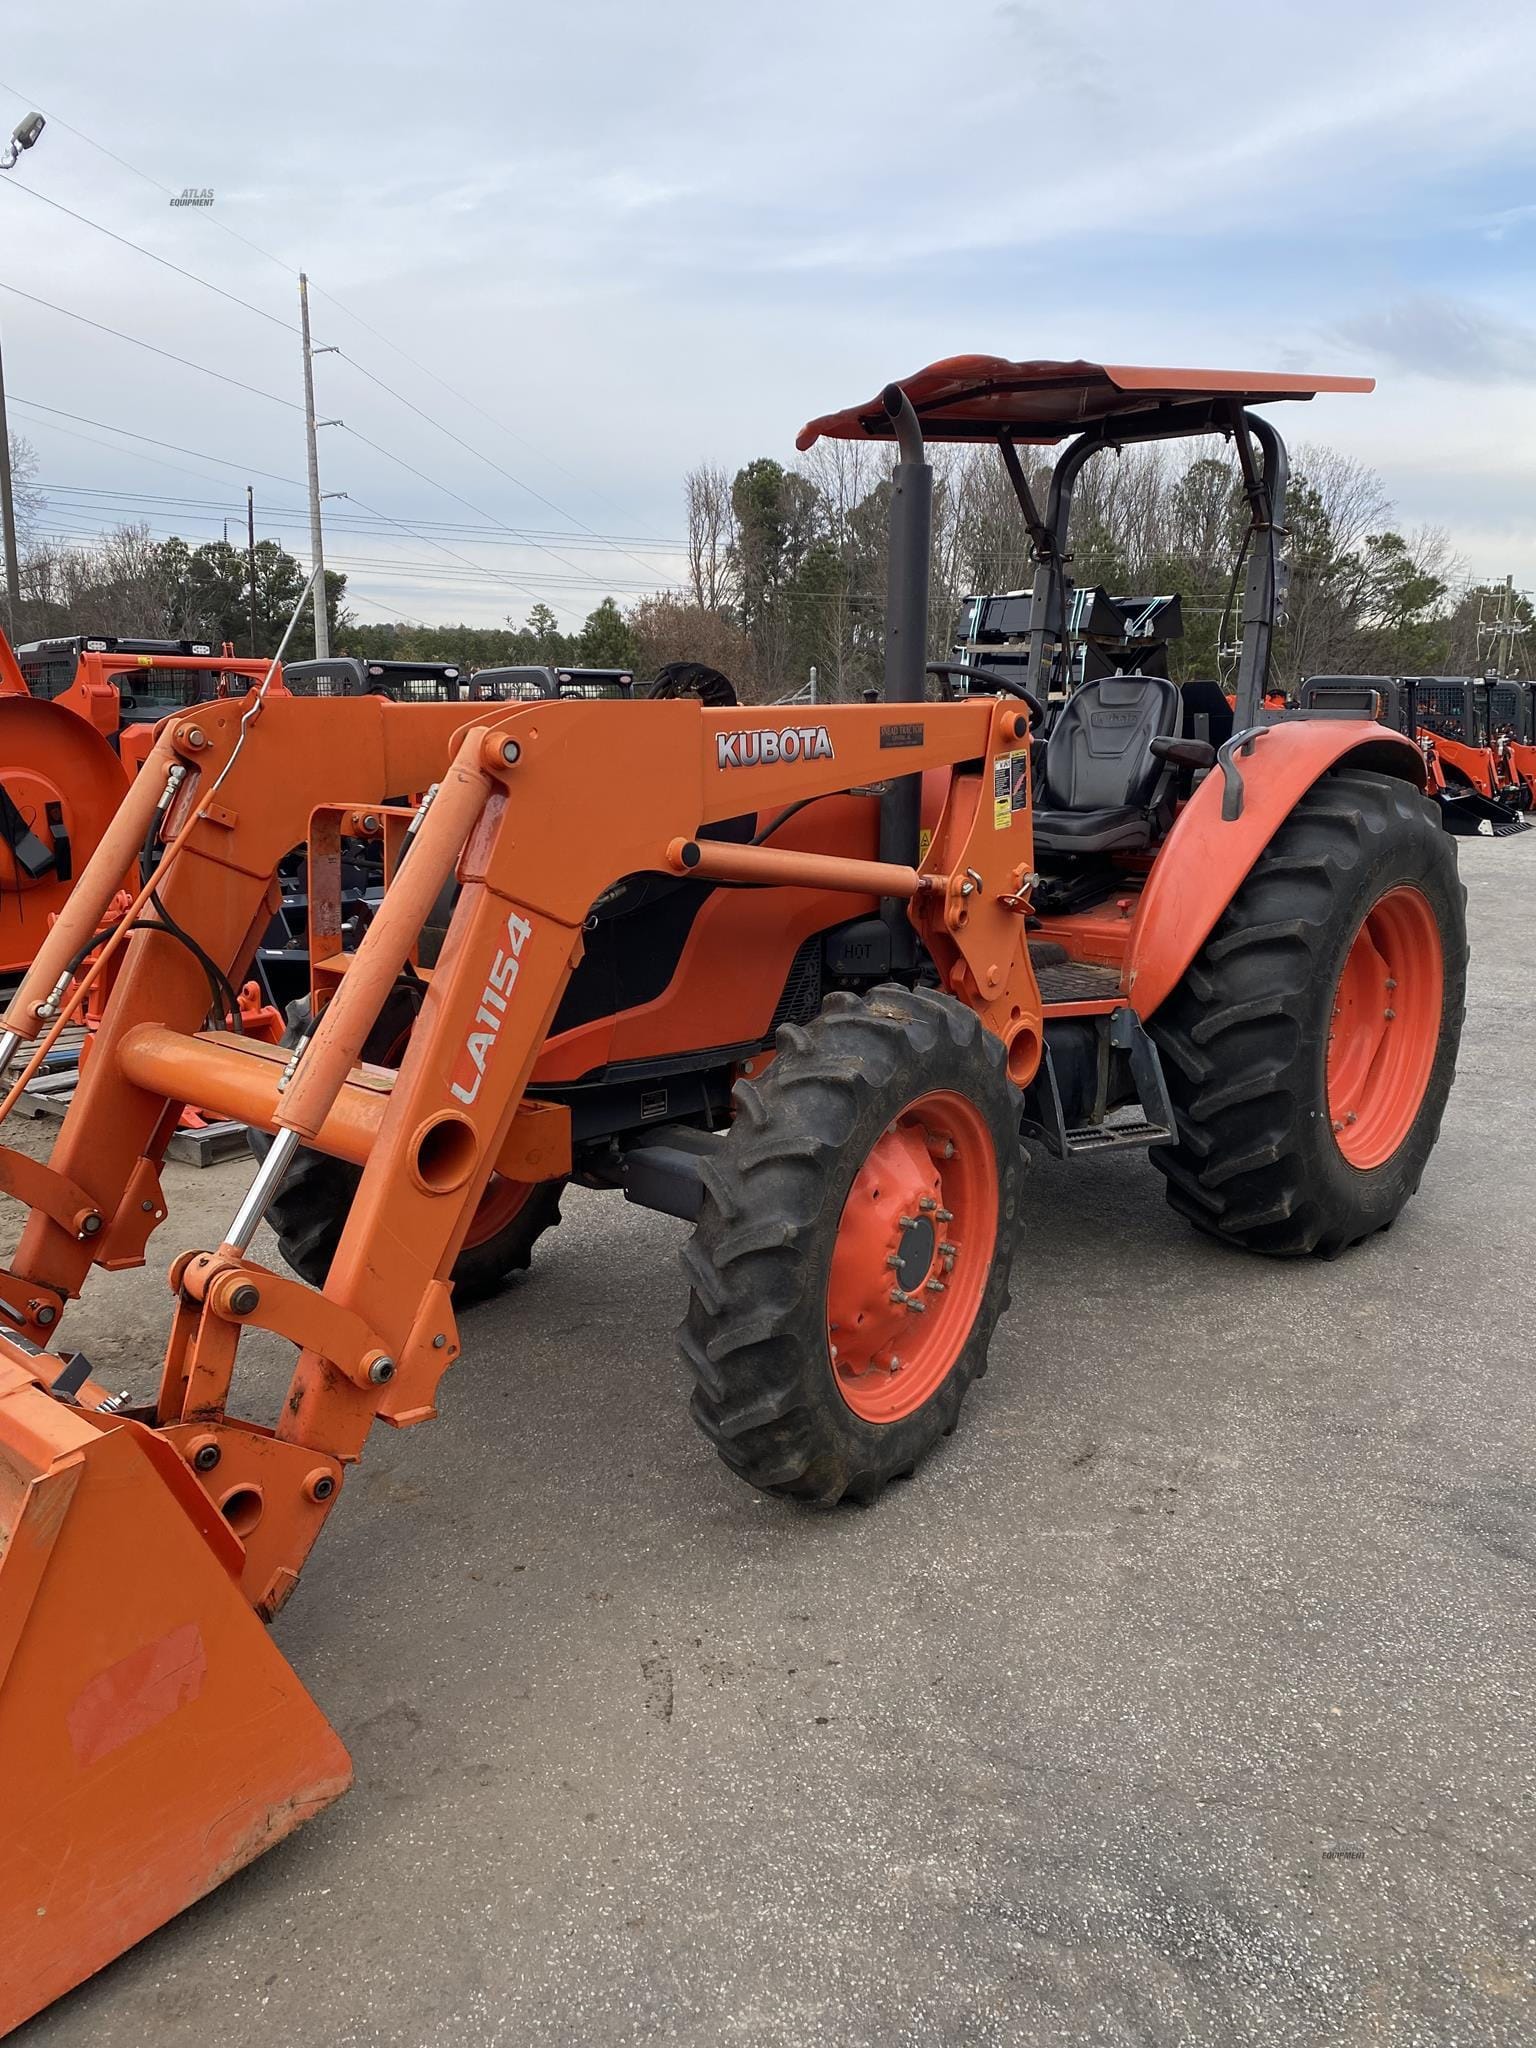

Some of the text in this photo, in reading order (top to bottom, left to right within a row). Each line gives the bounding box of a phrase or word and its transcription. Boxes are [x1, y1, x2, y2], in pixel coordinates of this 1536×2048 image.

[716, 725, 834, 770] KUBOTA
[844, 943, 873, 960] HOT
[450, 911, 532, 1105] LA1154
